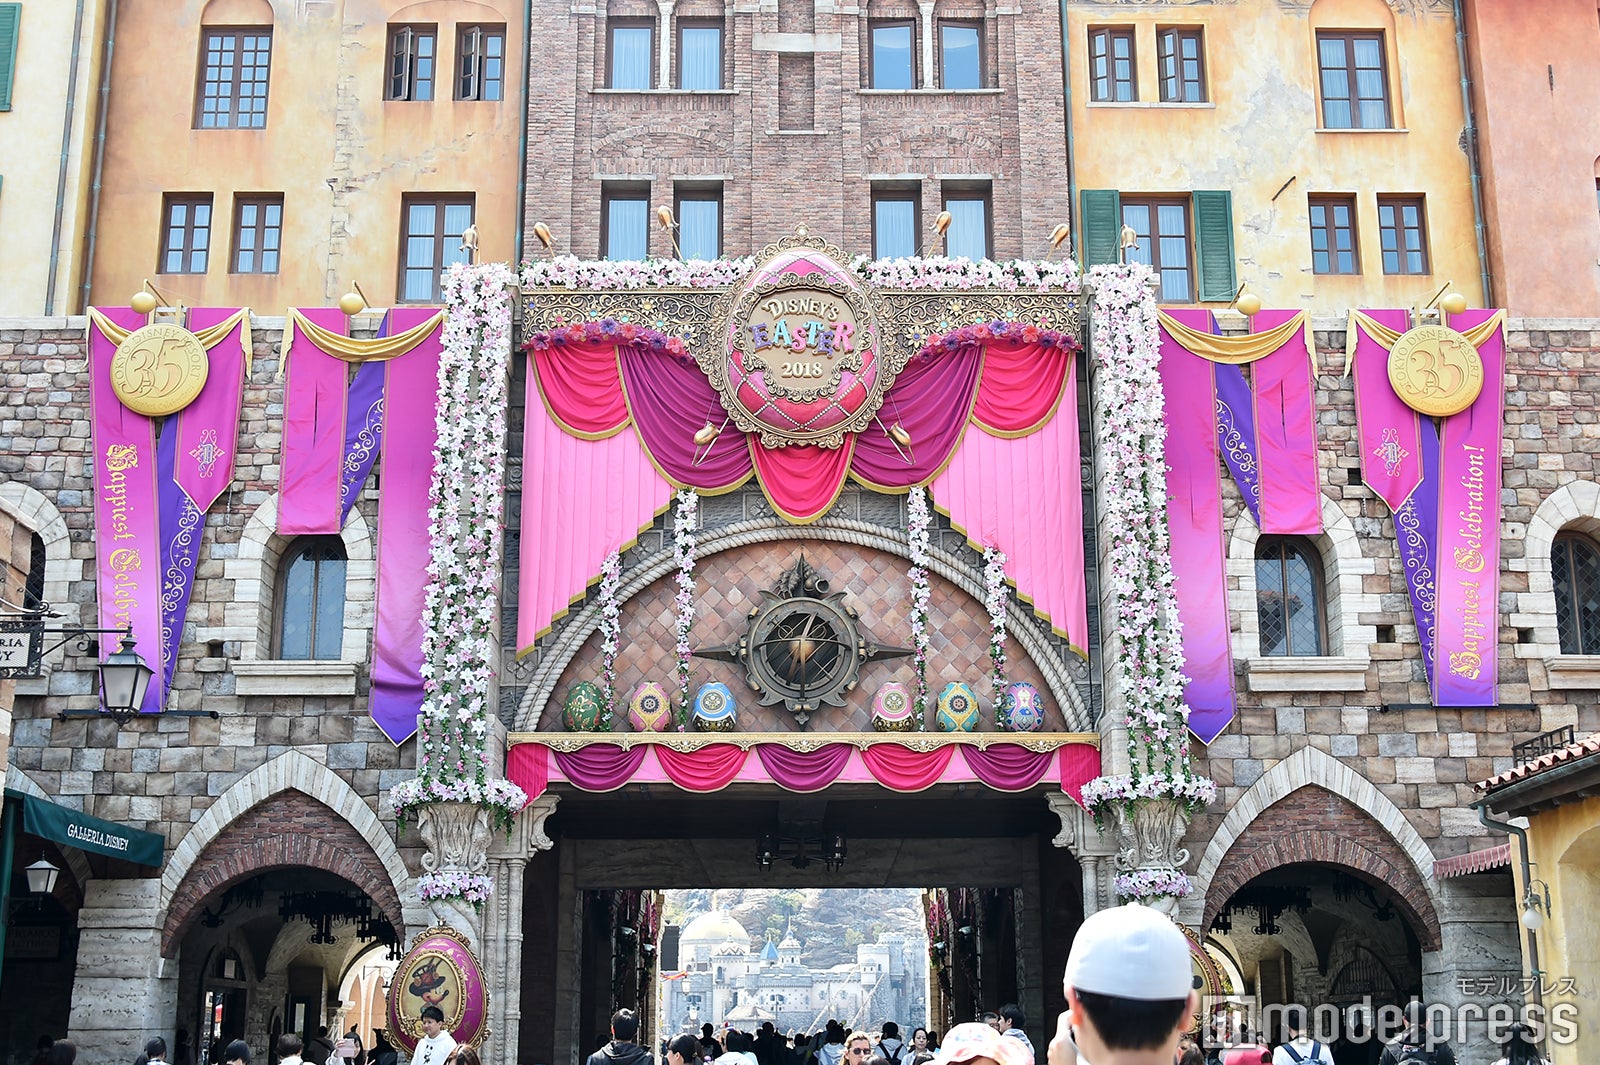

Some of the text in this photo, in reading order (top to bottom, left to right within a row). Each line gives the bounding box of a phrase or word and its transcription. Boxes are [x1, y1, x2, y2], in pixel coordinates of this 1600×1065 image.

[762, 298, 839, 322] DISNEY'S
[115, 328, 201, 388] TOKYO DISNEY RESORT
[748, 319, 855, 359] EASTER
[1395, 329, 1480, 389] TOKYO DISNEY RESORT
[781, 362, 823, 379] 2018
[104, 444, 138, 541] Happiest
[1449, 444, 1486, 680] Happiest Celebration!
[67, 823, 129, 851] GALLERIA DISNEY
